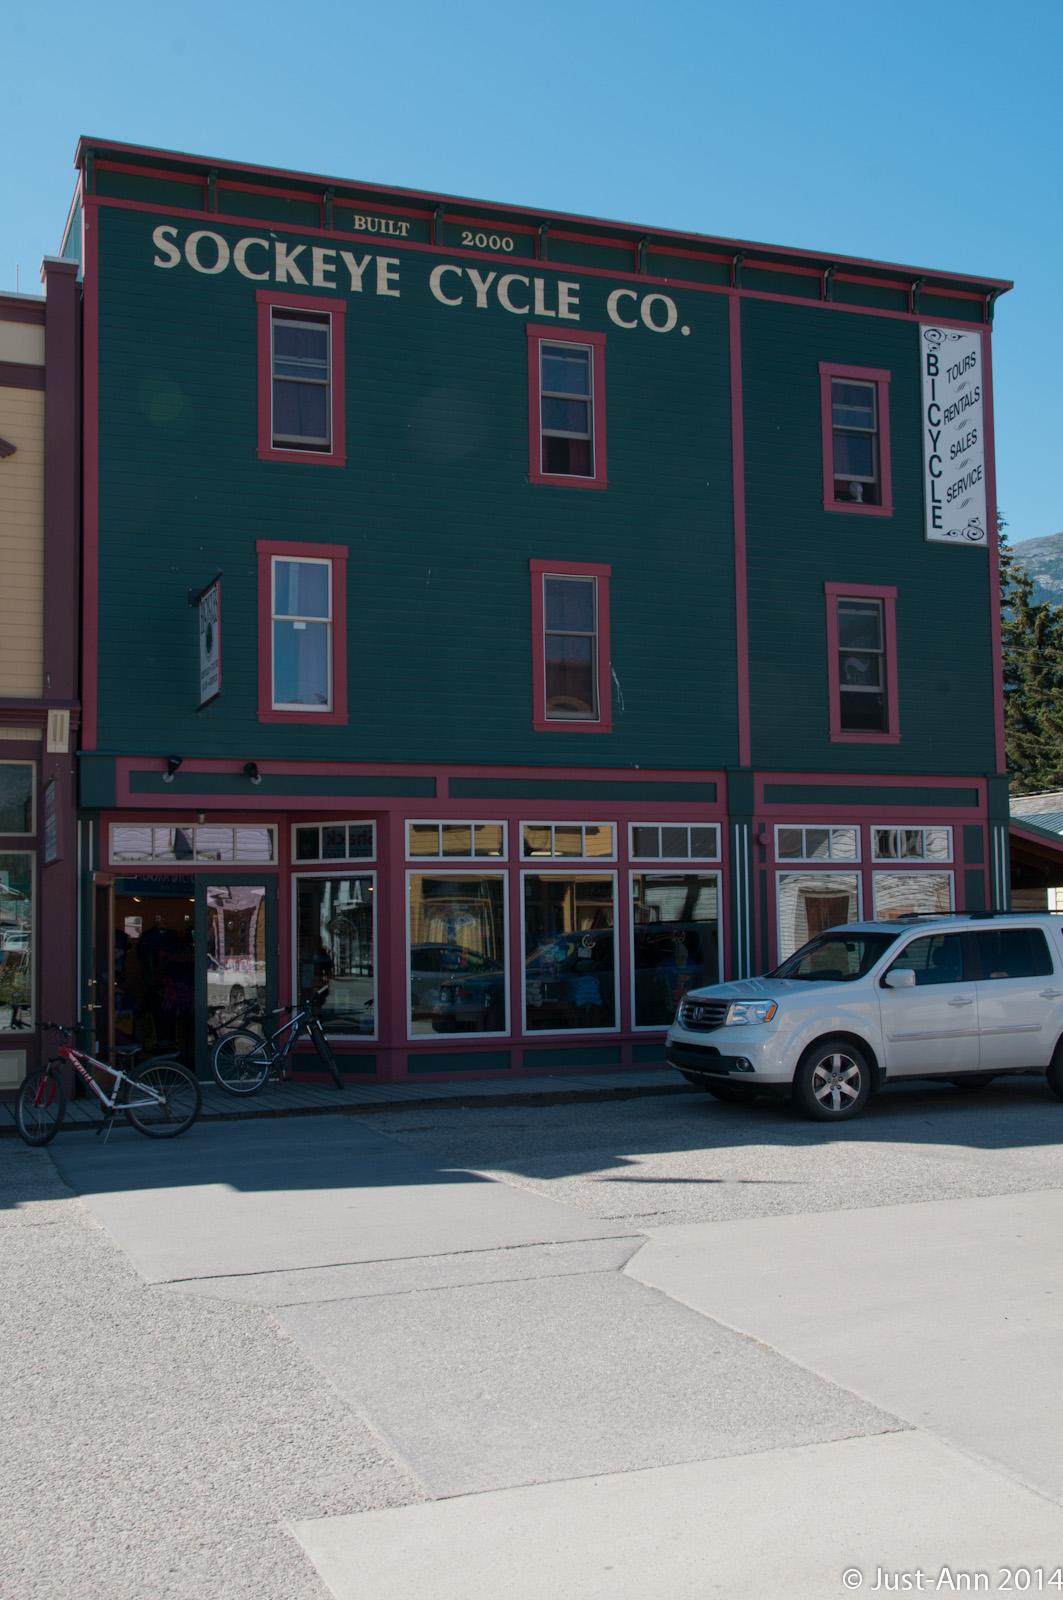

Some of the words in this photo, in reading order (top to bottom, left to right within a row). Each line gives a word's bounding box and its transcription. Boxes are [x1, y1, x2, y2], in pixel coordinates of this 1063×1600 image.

[353, 214, 410, 237] BUILT
[461, 231, 514, 252] 2000
[152, 225, 401, 298] SOCKEYE
[429, 264, 581, 321] CYCLE
[606, 288, 691, 336] CO.
[946, 351, 976, 384] TOURS
[943, 386, 981, 425] RENTALS
[926, 352, 943, 529] BICYCLE
[950, 428, 978, 461] SALES
[946, 465, 983, 503] SERVICE
